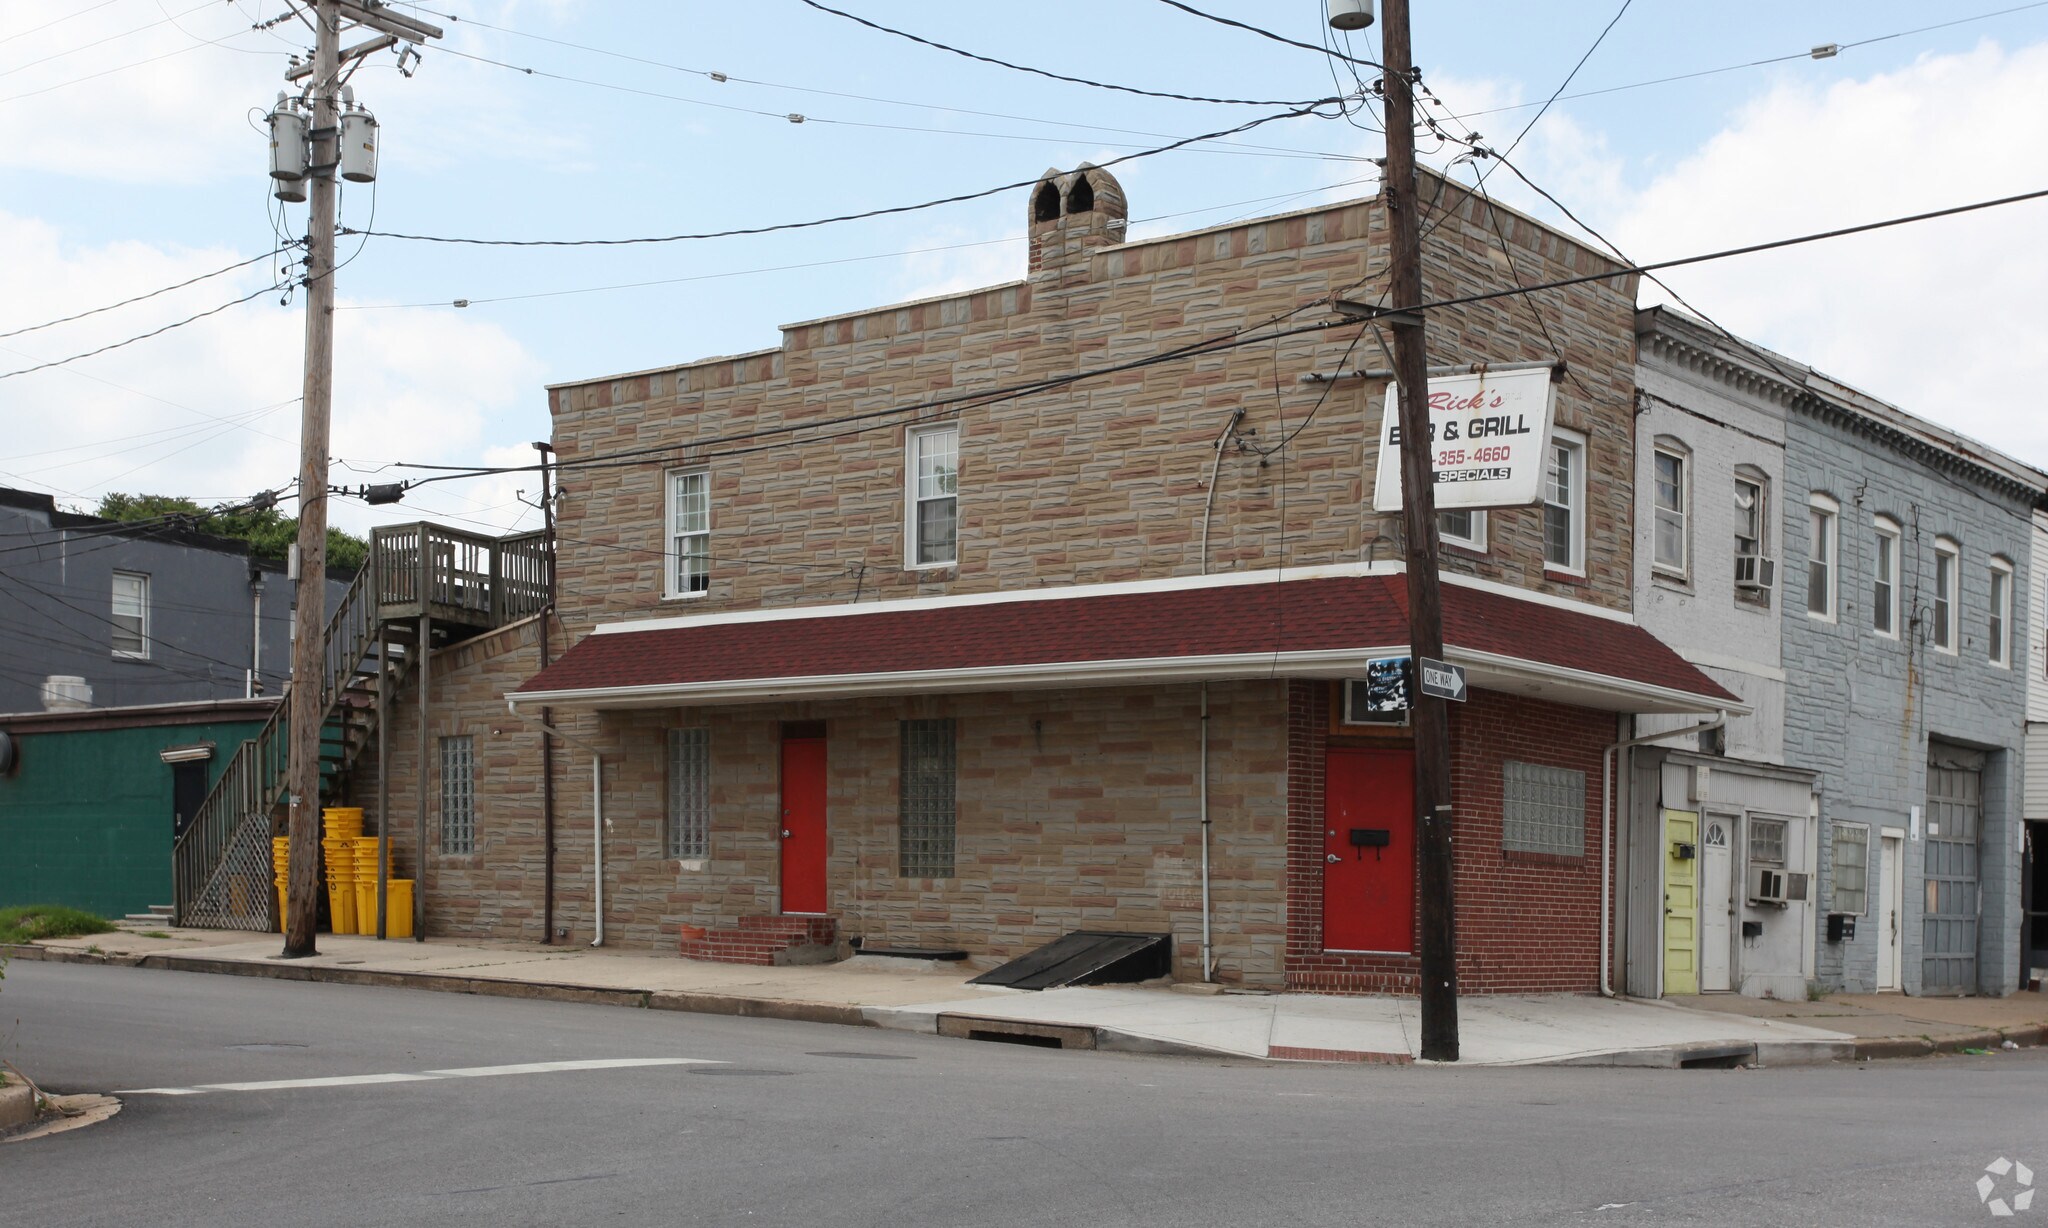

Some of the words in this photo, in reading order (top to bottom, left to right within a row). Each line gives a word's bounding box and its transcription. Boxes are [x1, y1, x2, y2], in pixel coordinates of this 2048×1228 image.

[1428, 389, 1505, 411] Rick's
[1443, 421, 1460, 441] &
[1468, 414, 1530, 439] GRILL
[1432, 446, 1511, 466] -355-4660
[1438, 468, 1509, 482] SPECIALS
[1425, 669, 1438, 685] ONE
[1439, 673, 1452, 688] WAY
